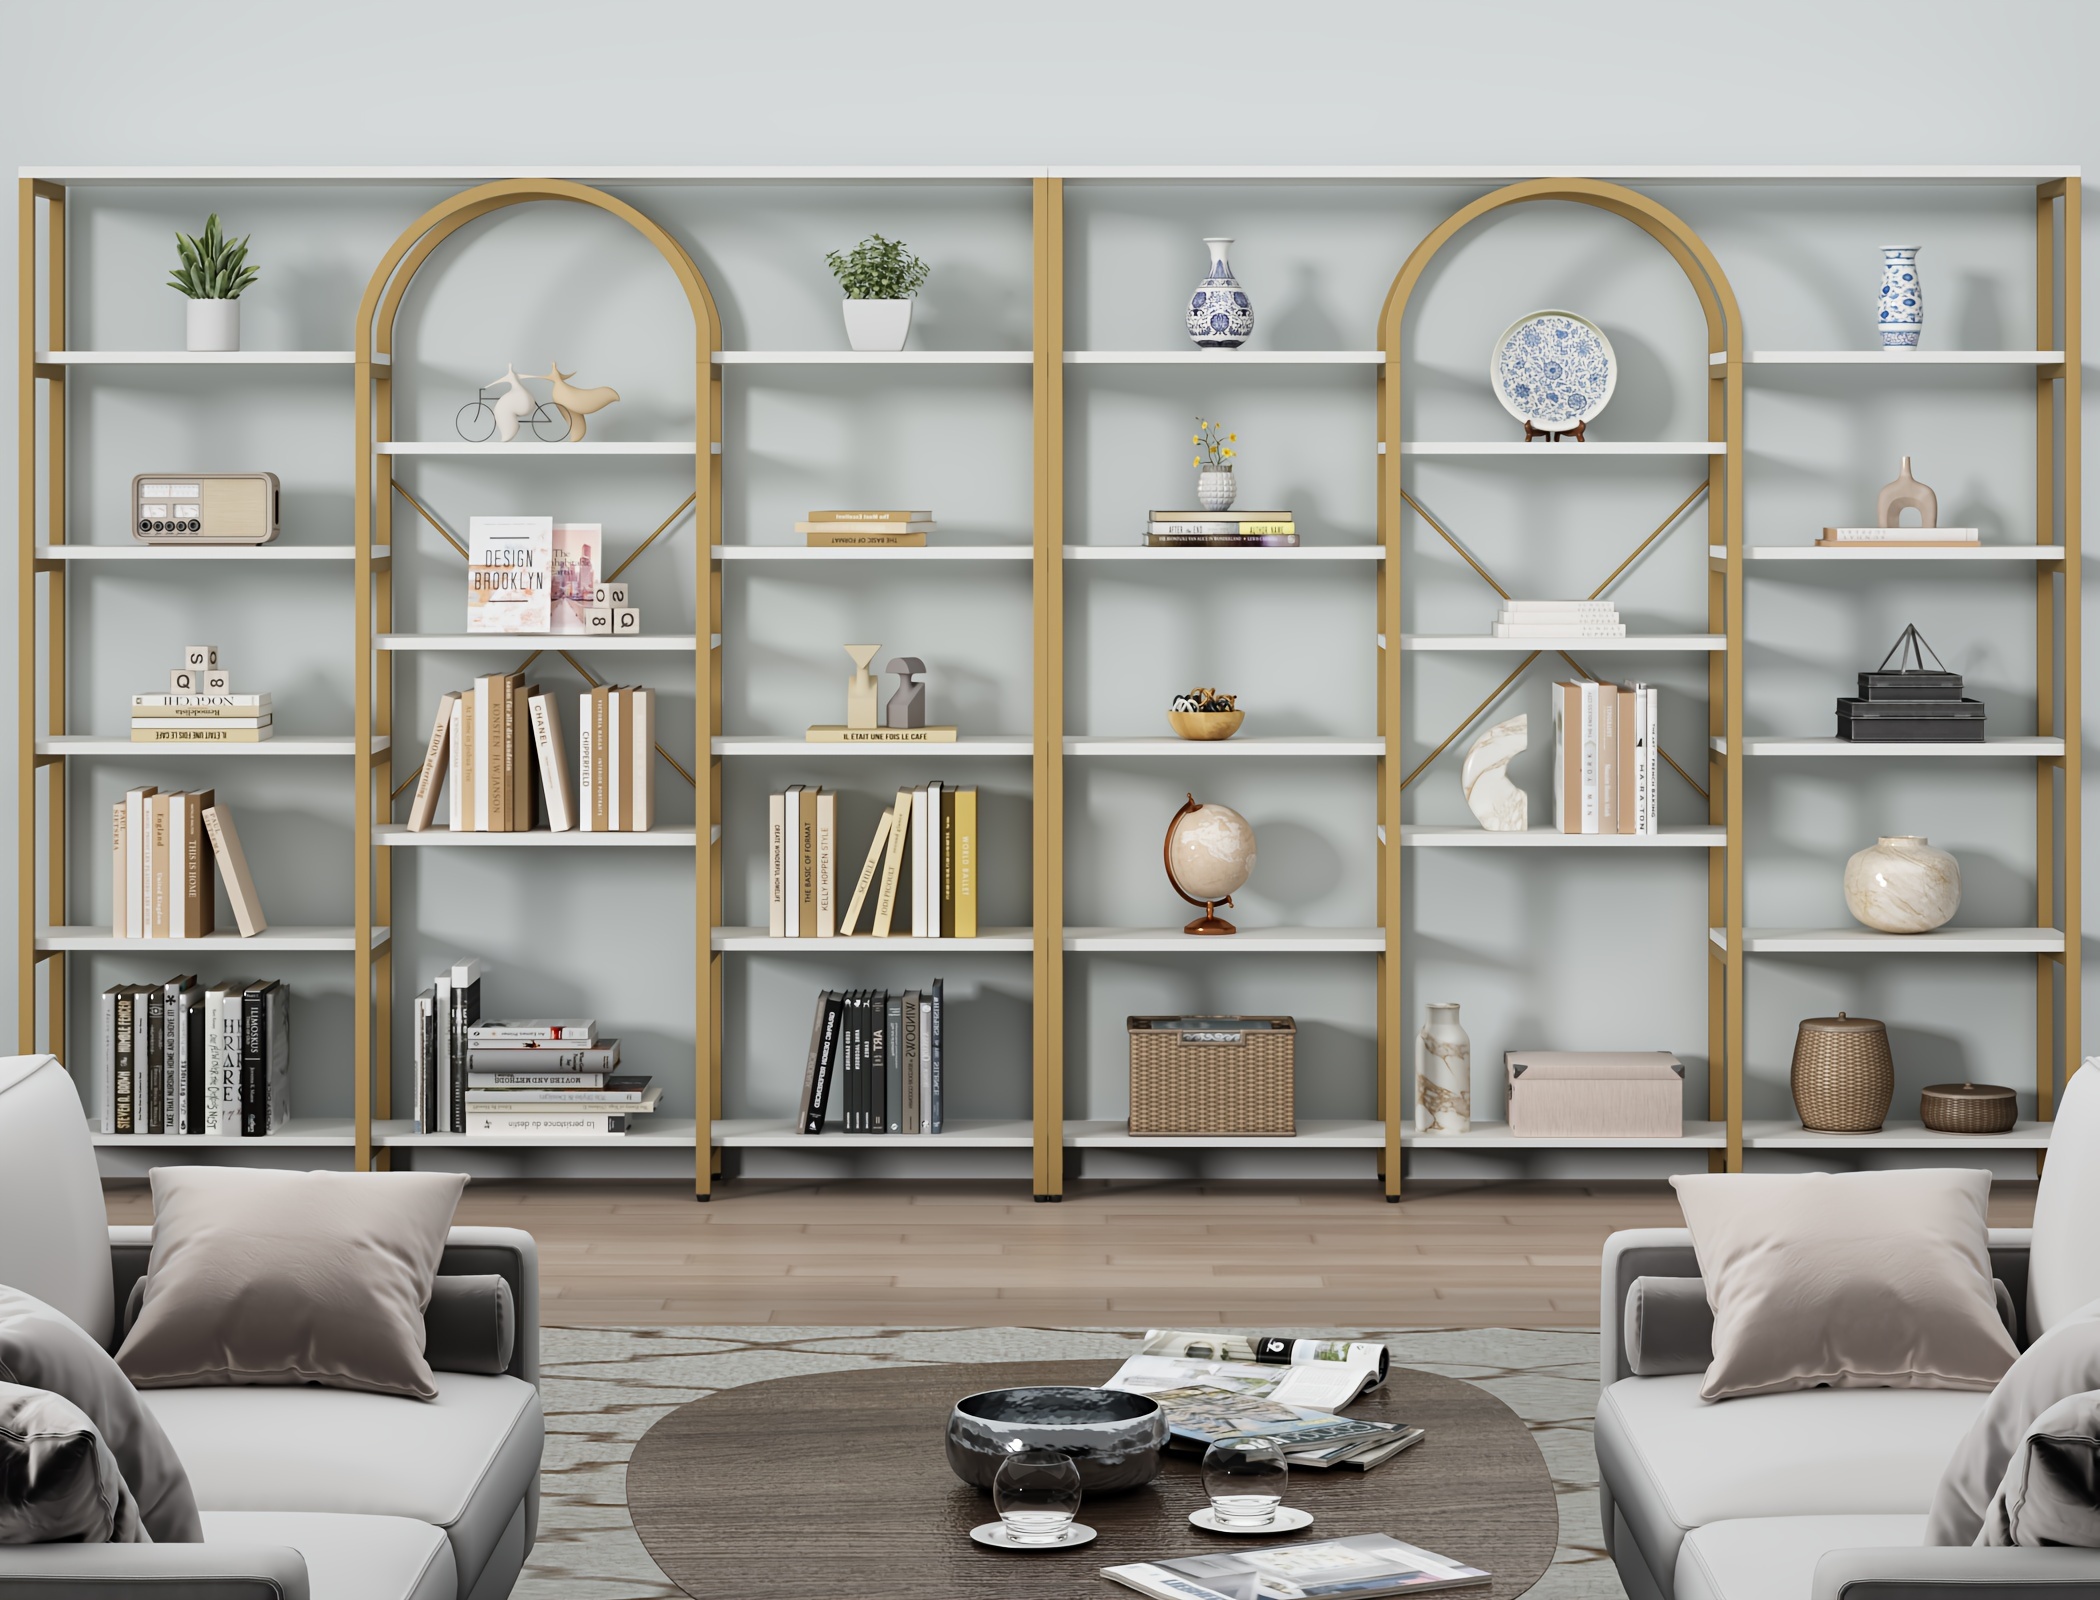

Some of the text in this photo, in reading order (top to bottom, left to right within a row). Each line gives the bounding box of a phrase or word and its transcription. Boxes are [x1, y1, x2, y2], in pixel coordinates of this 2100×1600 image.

[485, 549, 533, 567] DESIGN
[474, 572, 544, 591] BROOKLYN
[176, 674, 190, 689] Q
[210, 678, 224, 688] 8
[164, 696, 234, 706] NOGUCHI
[171, 731, 178, 739] LE
[179, 731, 191, 739] FOIS
[192, 731, 204, 739] UNE
[222, 731, 227, 739] IL
[493, 703, 501, 748] KONSTEN
[534, 705, 548, 747] CHANEL
[843, 732, 849, 741] IL
[871, 732, 884, 741] UNE
[885, 732, 900, 741] FOIS
[902, 732, 910, 741] LE
[416, 724, 444, 799] AVEDON advertising
[582, 731, 590, 787] CHIPPERFIELD
[156, 813, 164, 847] England
[210, 812, 221, 834] PAUL
[188, 840, 197, 898] THIS IS HOME
[804, 822, 812, 903] THE BASIC OF FORMAT
[821, 827, 829, 912] KELLY HOPPEN STYLE
[961, 836, 970, 896] WORLD BALLET
[859, 858, 876, 895] SCHIELE
[880, 866, 895, 916] JODI PICOULT
[166, 1019, 175, 1037] SHOVE
[250, 1007, 259, 1053] ILIMOSKUS
[166, 1038, 175, 1051] AND
[166, 1052, 175, 1069] HOME
[166, 1070, 175, 1096] NURSING
[166, 1098, 175, 1112] THAT
[117, 1103, 131, 1129] STEVEN
[166, 1114, 175, 1127] TAKE
[508, 1118, 595, 1129] La persistance du destin
